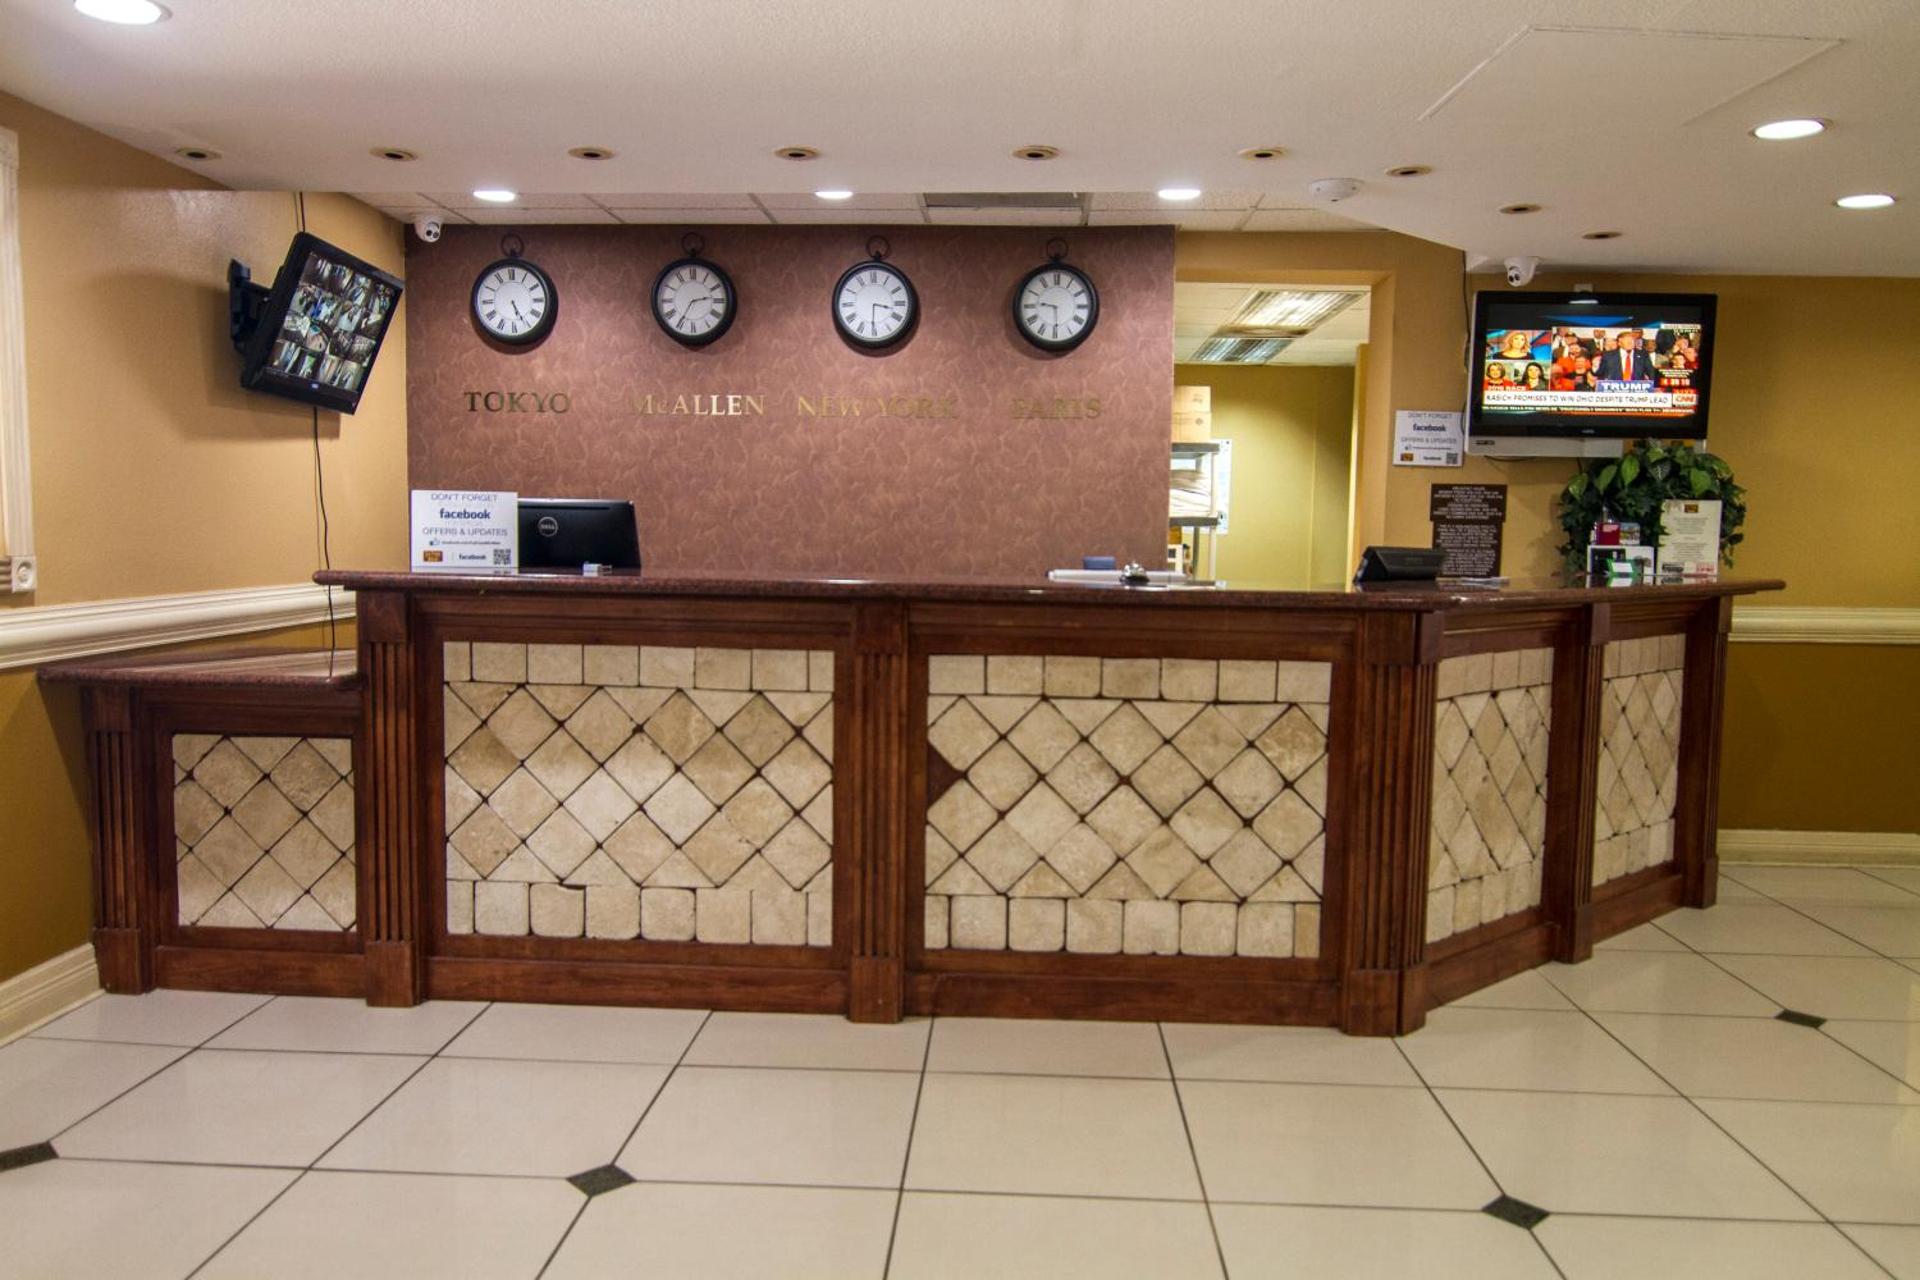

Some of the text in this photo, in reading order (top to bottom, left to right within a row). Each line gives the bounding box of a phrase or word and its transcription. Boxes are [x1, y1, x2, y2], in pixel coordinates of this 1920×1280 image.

[463, 391, 570, 414] TOKYO
[634, 393, 766, 416] McALLEN
[1649, 396, 1668, 404] LEAD
[797, 395, 958, 419] NEW YORK
[1413, 423, 1446, 431] facebook
[461, 494, 498, 502] FORGET
[439, 507, 491, 520] facebook
[423, 527, 508, 538] OFFERS & UPDATES
[458, 553, 487, 561] facebook
